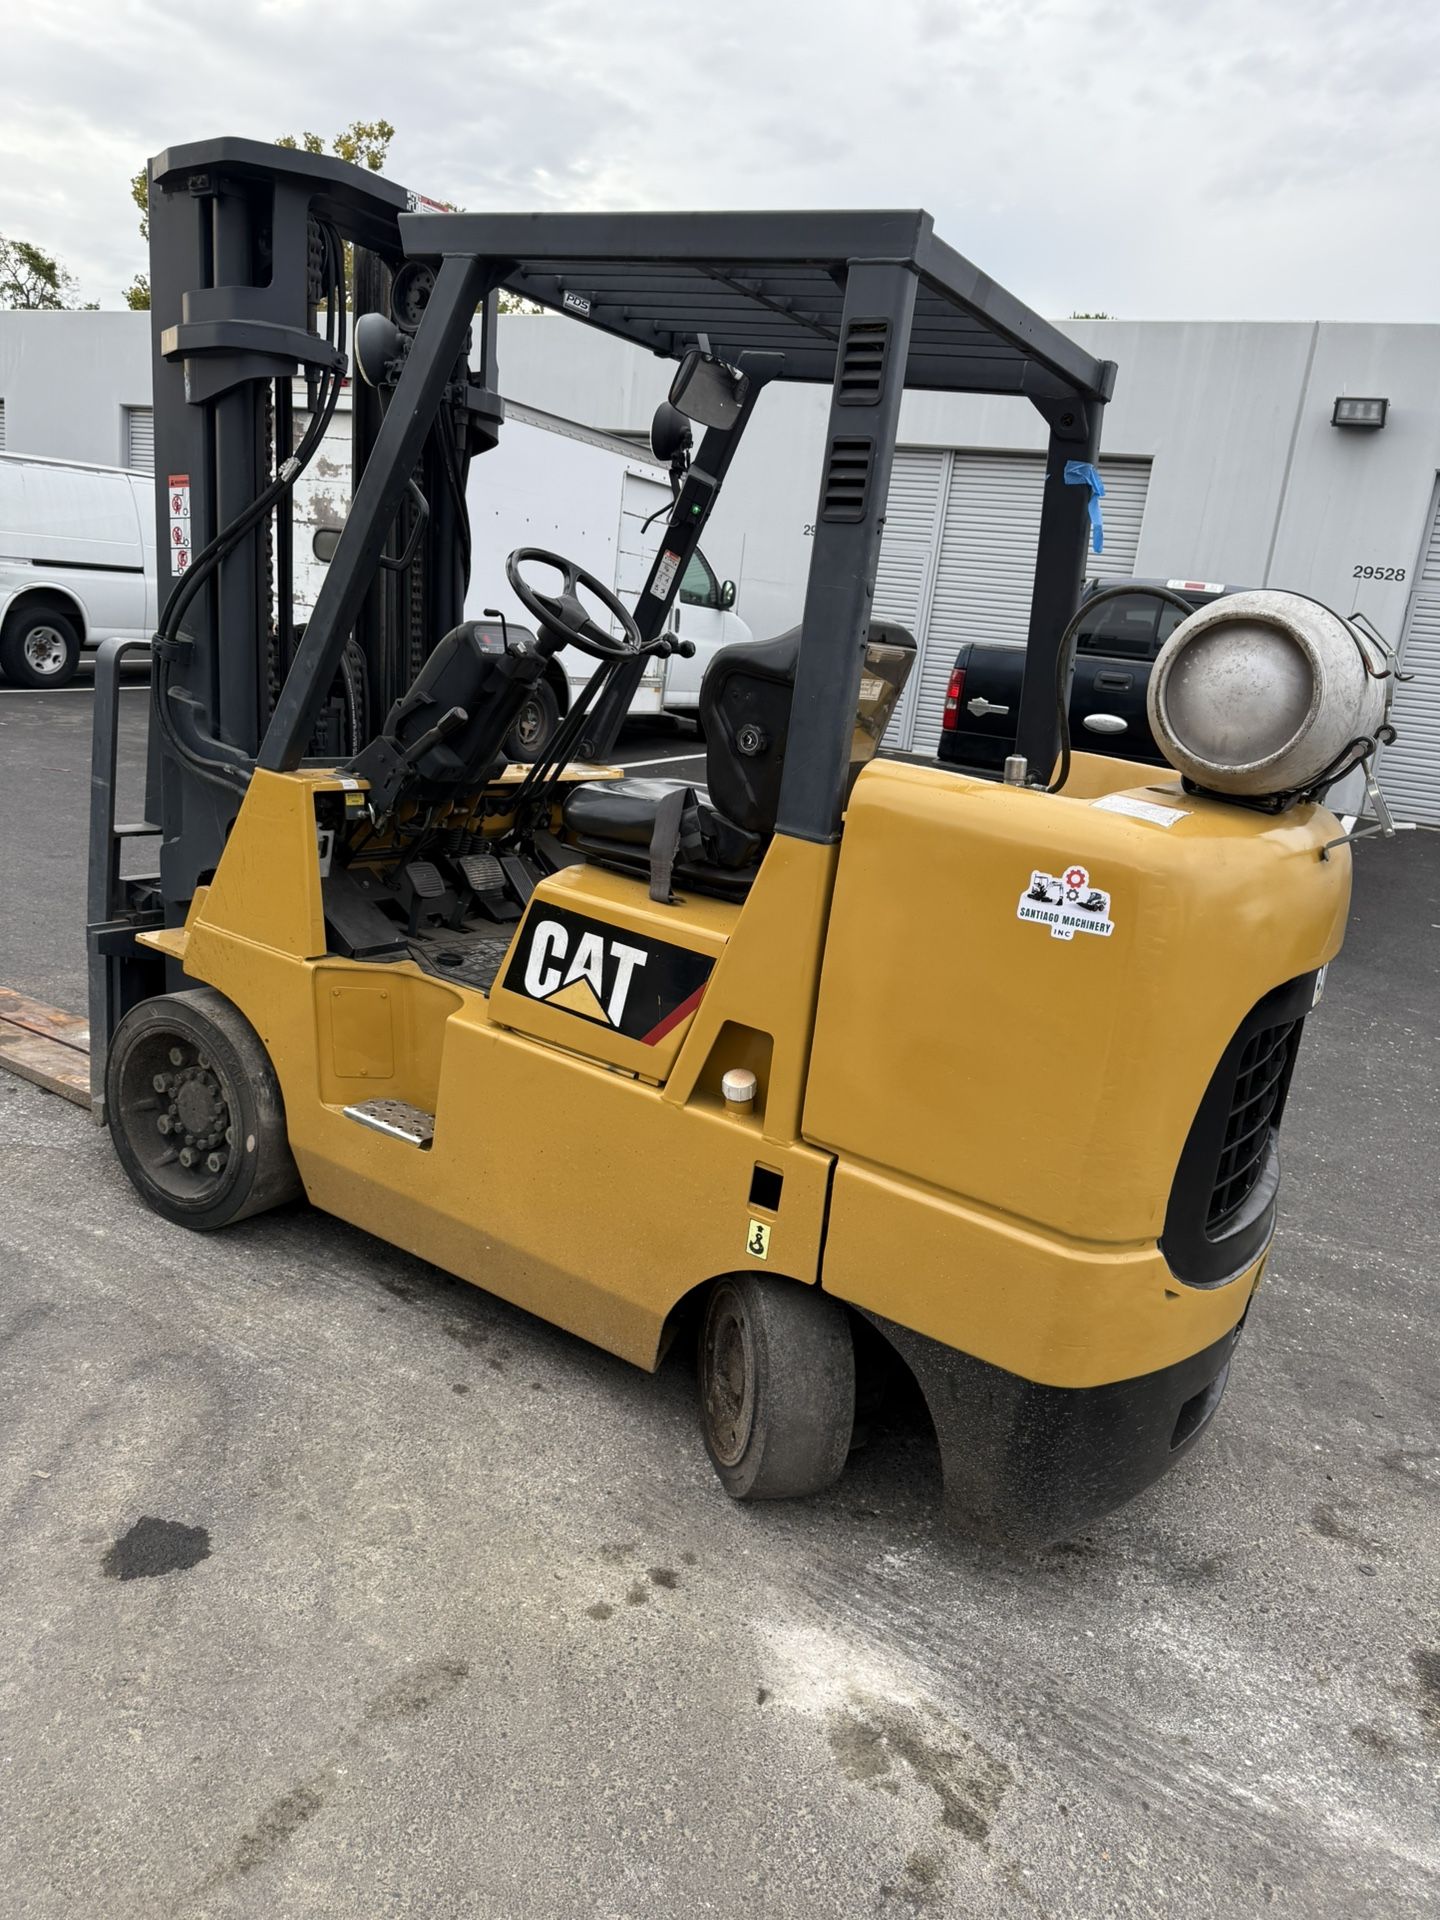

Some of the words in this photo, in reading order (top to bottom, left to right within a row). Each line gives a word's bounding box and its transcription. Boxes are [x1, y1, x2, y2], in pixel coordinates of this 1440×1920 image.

[567, 293, 588, 310] PDS
[1352, 565, 1406, 581] 29528
[1019, 907, 1060, 923] SANTIAGO
[1061, 915, 1111, 933] MACHINERY
[1053, 928, 1071, 937] INC
[524, 920, 648, 1028] CAT
